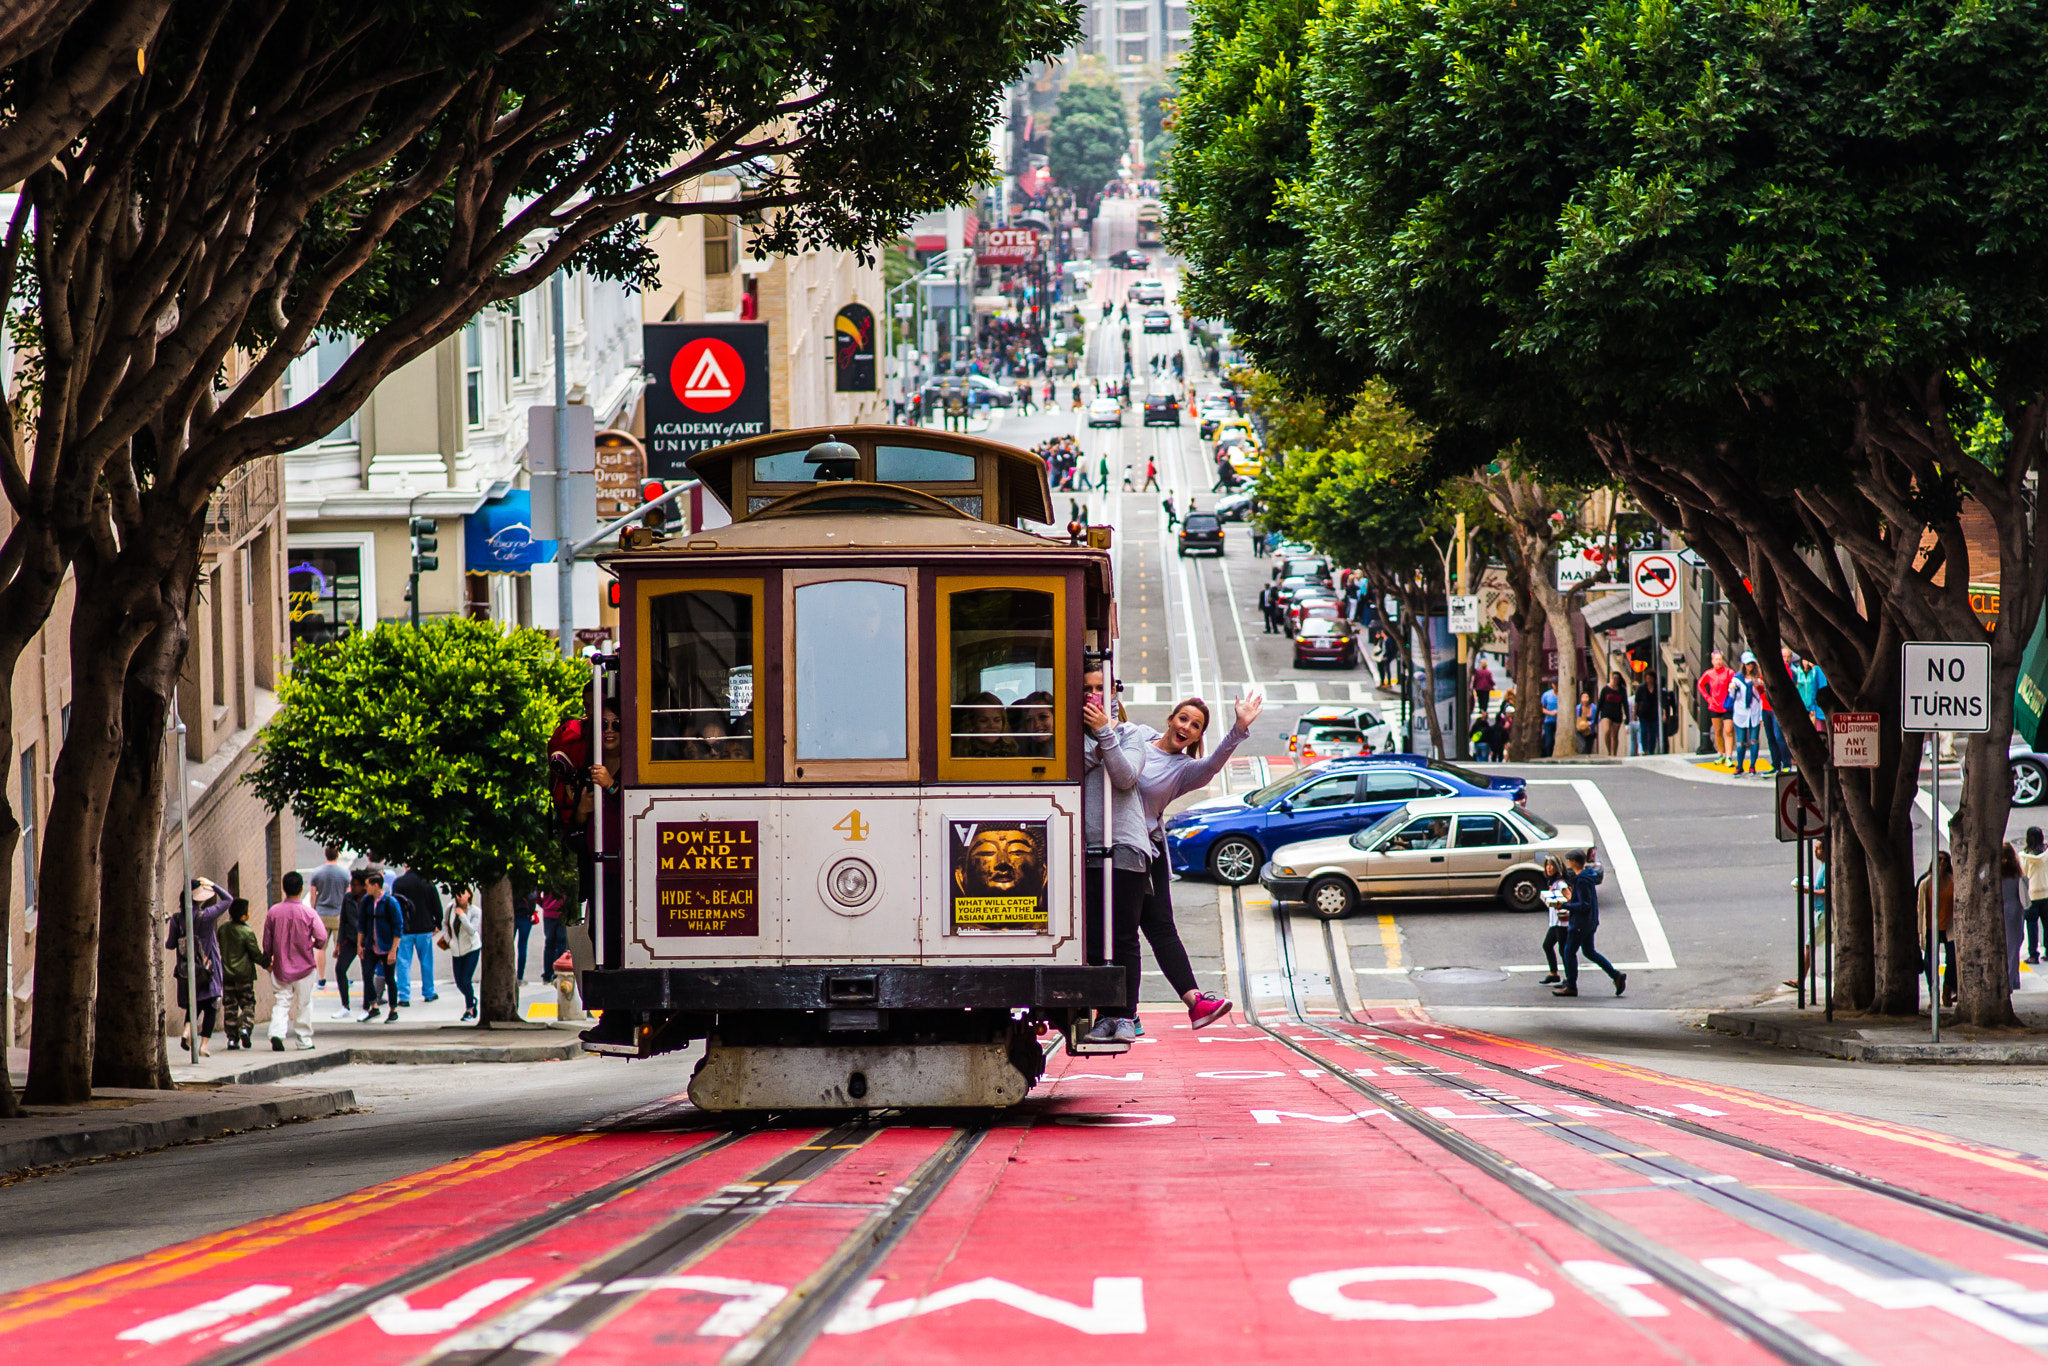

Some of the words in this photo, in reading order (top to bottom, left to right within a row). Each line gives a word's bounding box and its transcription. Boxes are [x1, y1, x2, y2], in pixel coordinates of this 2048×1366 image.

[978, 230, 1035, 246] HOTEL
[654, 422, 723, 435] ACADEMY
[723, 422, 737, 437] of
[736, 422, 763, 434] ART
[654, 439, 743, 451] UNIVER
[596, 451, 622, 468] Last
[595, 468, 628, 485] Drop
[1654, 599, 1660, 610] 3
[1969, 594, 2000, 614] CLE
[1928, 658, 1965, 683] NO
[1910, 696, 1983, 717] TURNS
[1834, 722, 1847, 733] NO
[1848, 724, 1878, 733] STOPPING
[1846, 738, 1866, 746] ANY
[1844, 747, 1868, 756] TIME
[832, 809, 870, 841] 4
[662, 830, 752, 845] POWELL
[686, 845, 731, 856] AND
[661, 856, 754, 870] MARKET
[661, 890, 692, 906] HYDE
[712, 889, 753, 905] BEACH
[669, 909, 746, 920] FISHERMANS
[687, 920, 728, 931] WHARF
[1250, 1103, 1728, 1124] MUNI
